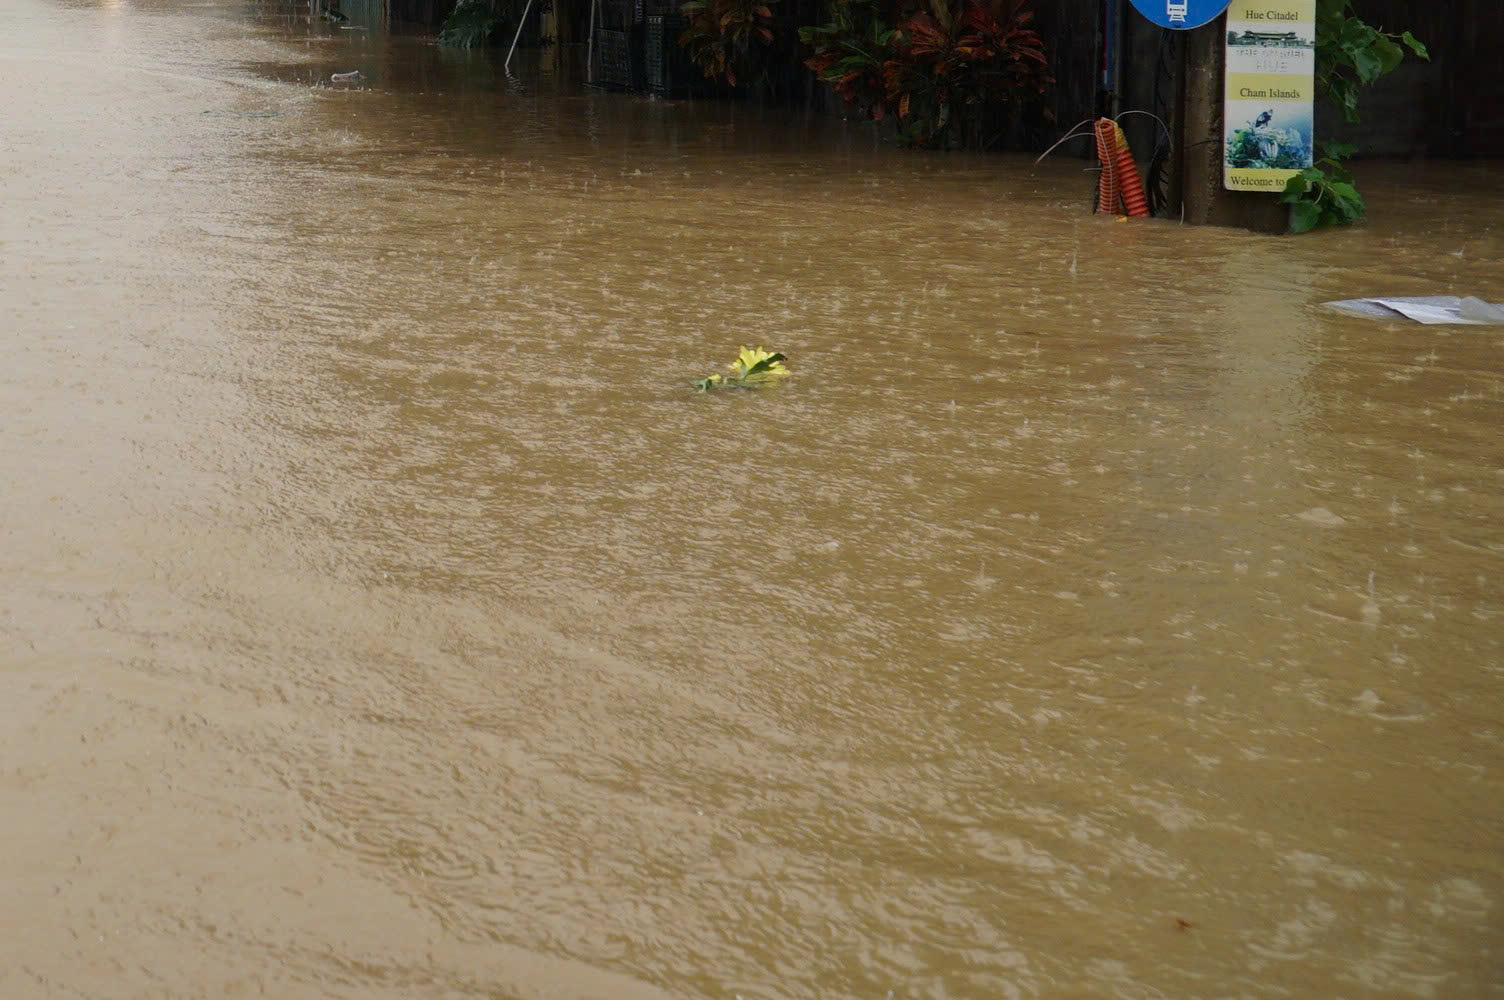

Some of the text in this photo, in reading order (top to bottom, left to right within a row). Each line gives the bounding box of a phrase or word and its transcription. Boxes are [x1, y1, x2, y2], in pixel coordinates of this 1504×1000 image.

[1245, 8, 1299, 21] Hue Citadel
[1240, 87, 1301, 99] Cham Islands
[1231, 175, 1285, 187] Welcome to
